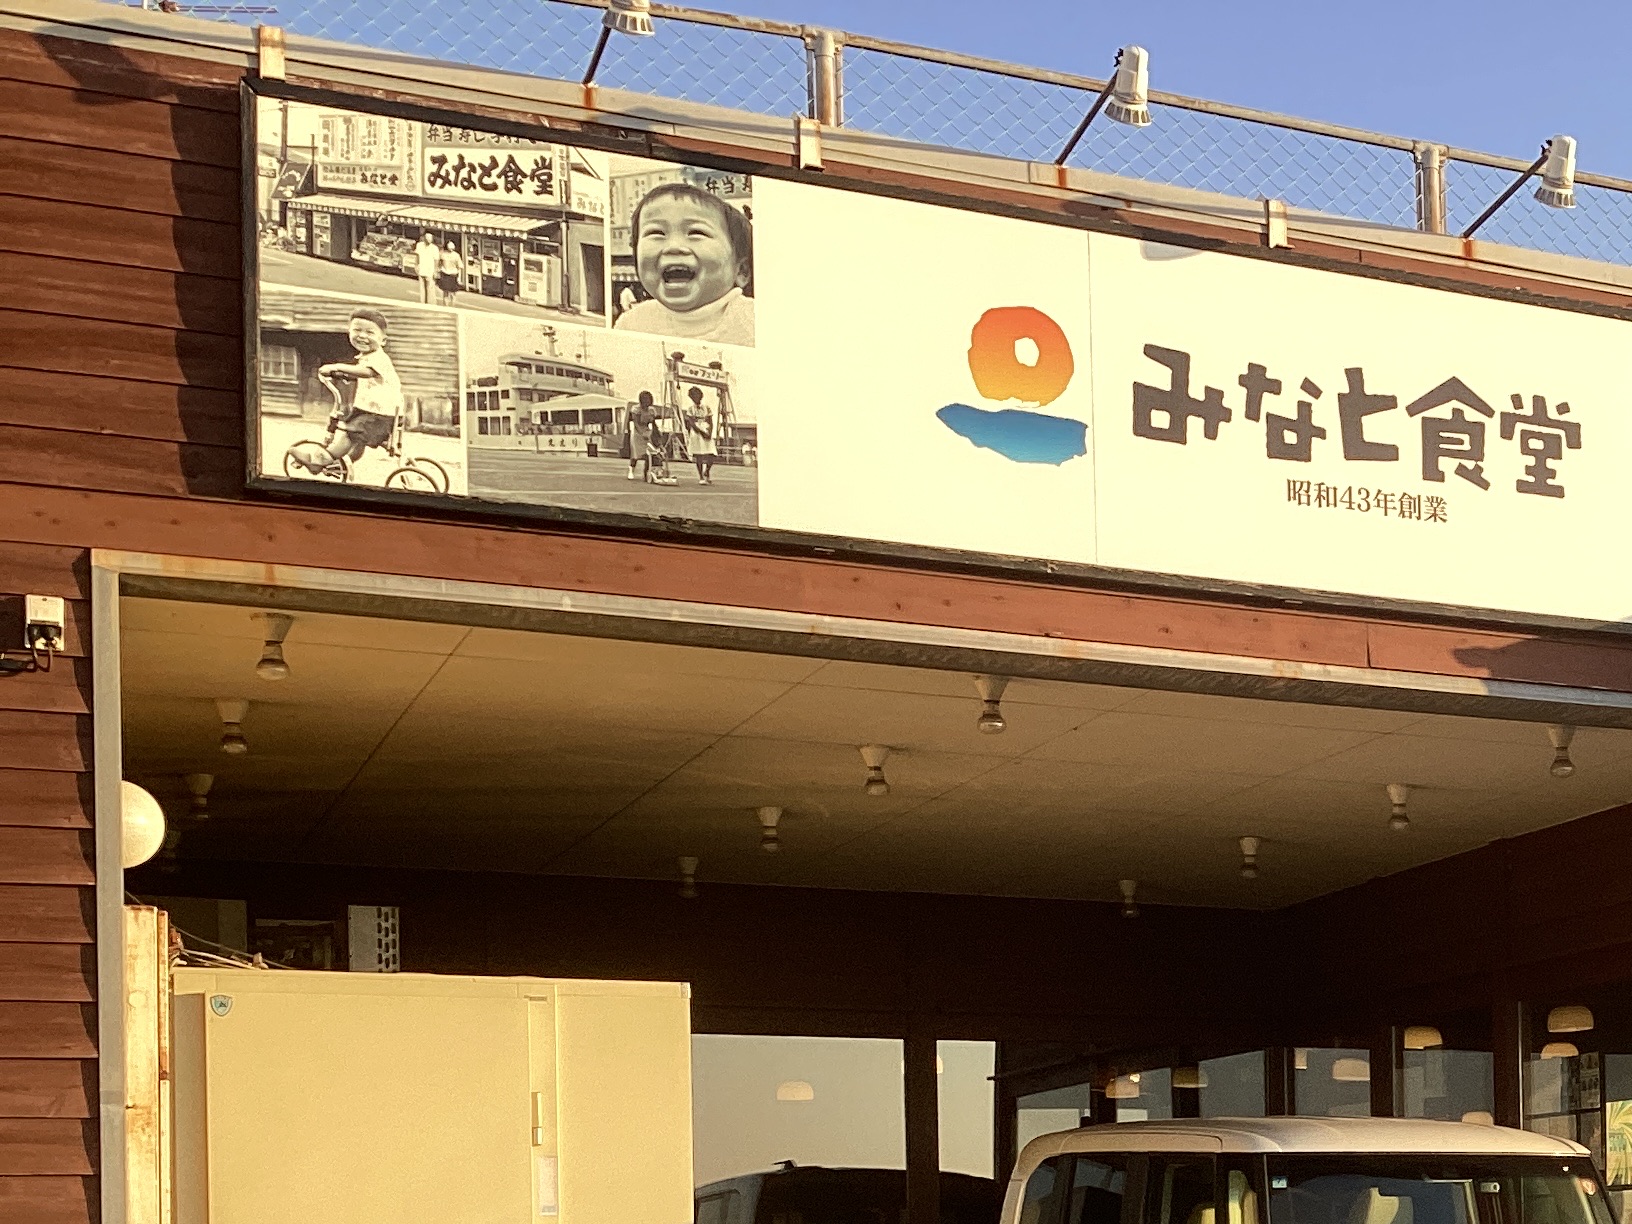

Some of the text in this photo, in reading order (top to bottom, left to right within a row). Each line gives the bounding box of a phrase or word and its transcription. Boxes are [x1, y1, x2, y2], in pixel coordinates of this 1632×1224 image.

[427, 153, 553, 197] みなと食堂
[1132, 343, 1582, 498] みなと食堂
[1285, 478, 1448, 523] 昭和43年創業
